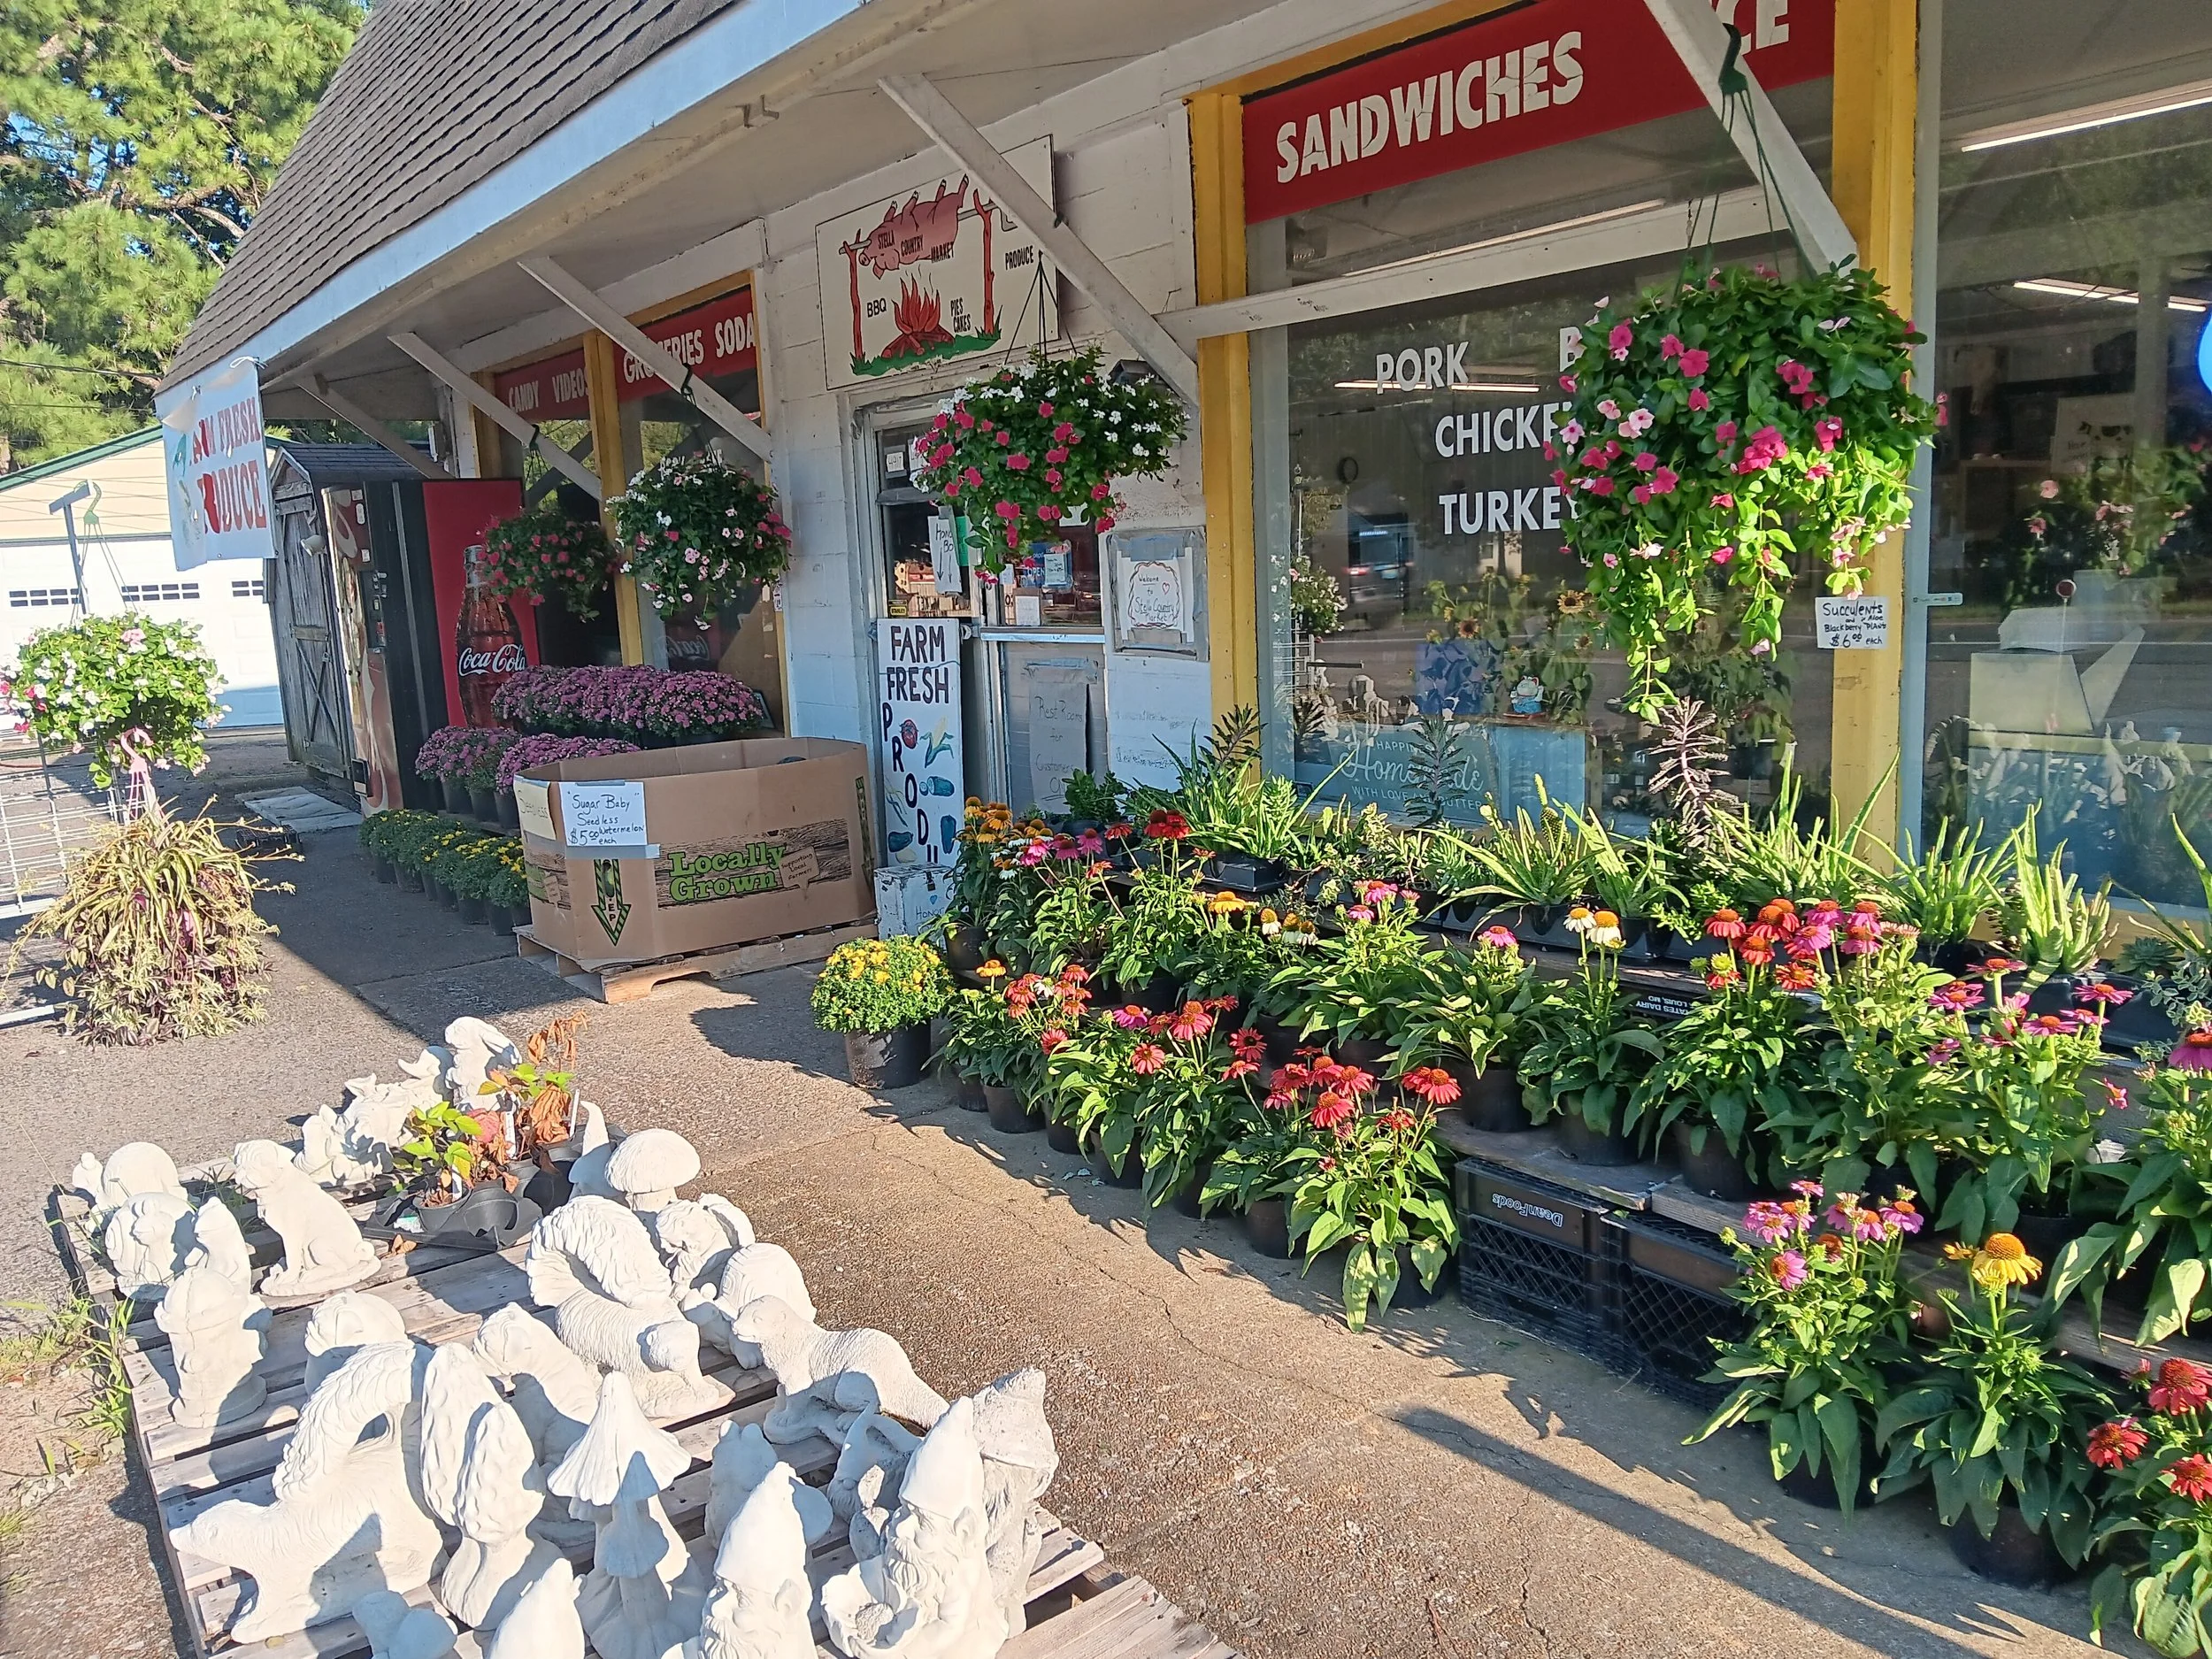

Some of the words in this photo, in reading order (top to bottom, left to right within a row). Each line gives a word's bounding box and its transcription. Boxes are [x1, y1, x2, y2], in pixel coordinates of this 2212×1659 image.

[1276, 31, 1584, 183] SANDWICHES
[878, 230, 895, 250] STELLA
[901, 234, 924, 257] COUNTRY
[931, 242, 955, 264] MARKET
[1005, 245, 1034, 271] PRODUCE
[867, 297, 887, 319] BBQ
[950, 297, 964, 317] PIES
[953, 314, 972, 334] CAKES
[1376, 342, 1469, 395] PORK
[552, 368, 589, 403] VIDEO
[218, 396, 260, 452] FRESH
[1138, 573, 1159, 582] Welcome
[1823, 600, 1884, 617] Succulents
[1824, 624, 1863, 634] Blackberry
[891, 625, 946, 664] FARM
[458, 643, 526, 677] Coca-Cola
[887, 665, 949, 704] FRESH
[1351, 785, 1379, 797] WITH
[1381, 788, 1409, 803] LOVE
[577, 812, 618, 826] Seedless
[599, 822, 644, 835] Watermelon
[668, 841, 786, 877] Locally
[780, 852, 813, 869] Supporting
[789, 862, 807, 872] Local
[669, 871, 778, 902] Grown
[1635, 1000, 1662, 1011] DAIRY
[1663, 996, 1688, 1008] LOUIS,
[1492, 1193, 1563, 1227] DeanFoods
